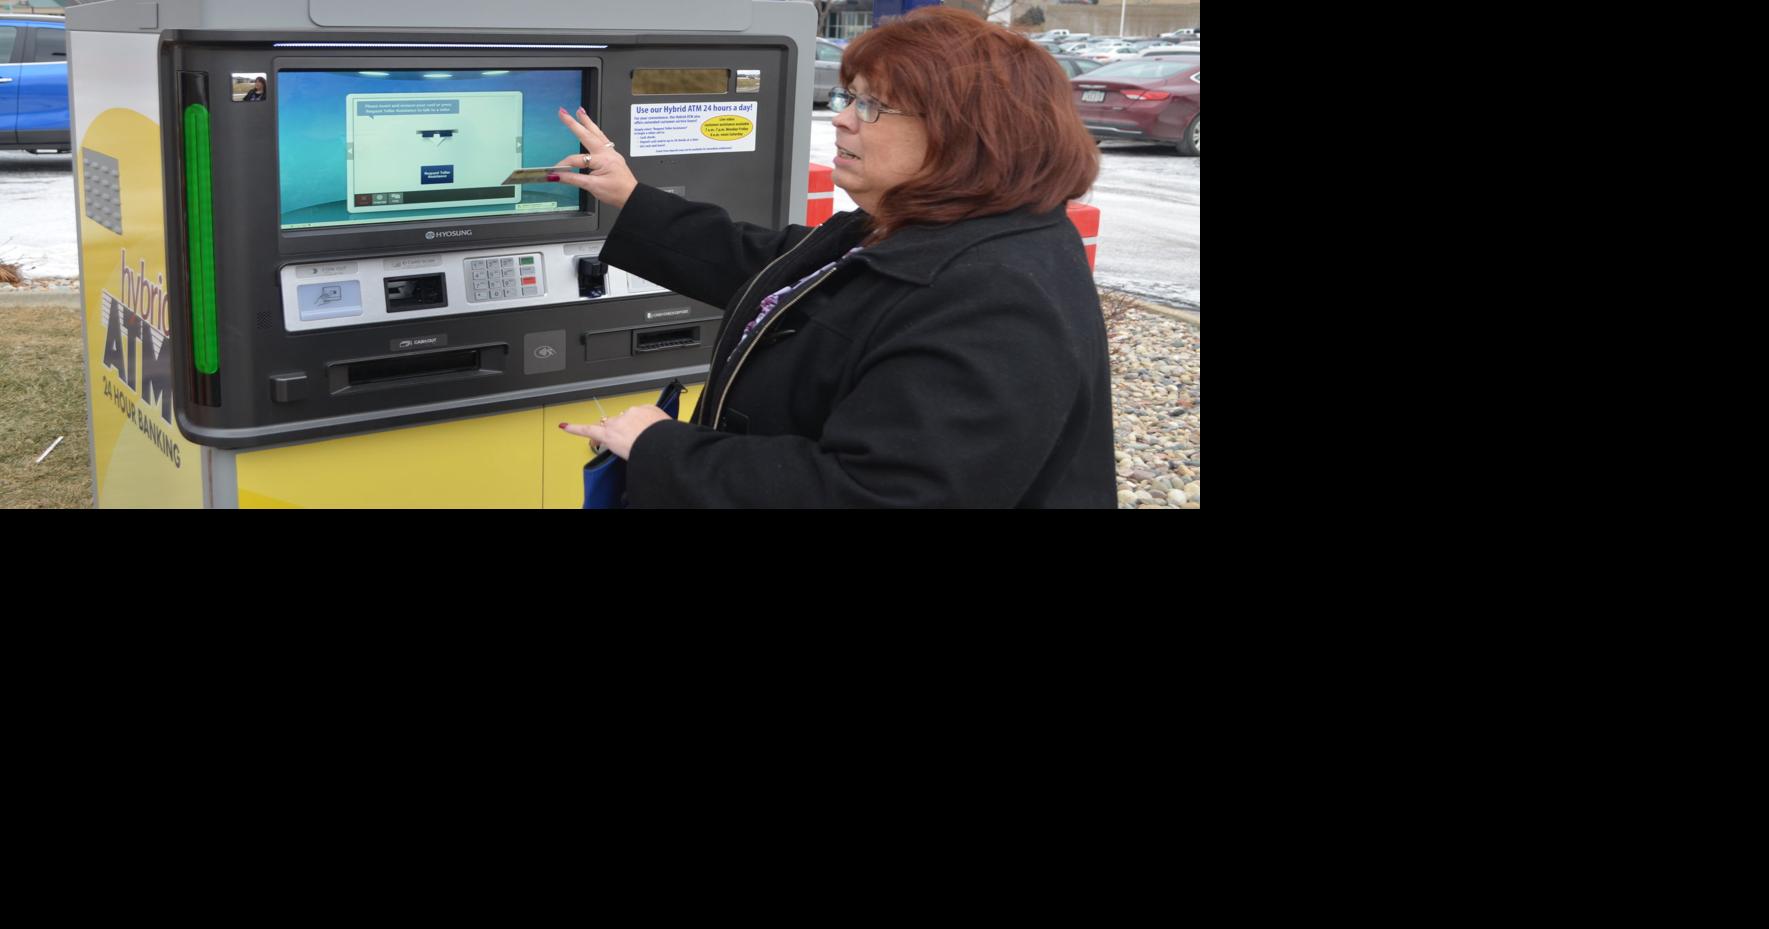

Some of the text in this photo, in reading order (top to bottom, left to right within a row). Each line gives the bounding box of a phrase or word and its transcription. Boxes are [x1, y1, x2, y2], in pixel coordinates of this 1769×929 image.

[664, 105, 686, 114] Hybrid
[738, 104, 752, 112] day!
[436, 230, 472, 238] HYOSUNG
[103, 297, 172, 425] ATM
[103, 376, 181, 468] 24 HOUR BANKING
